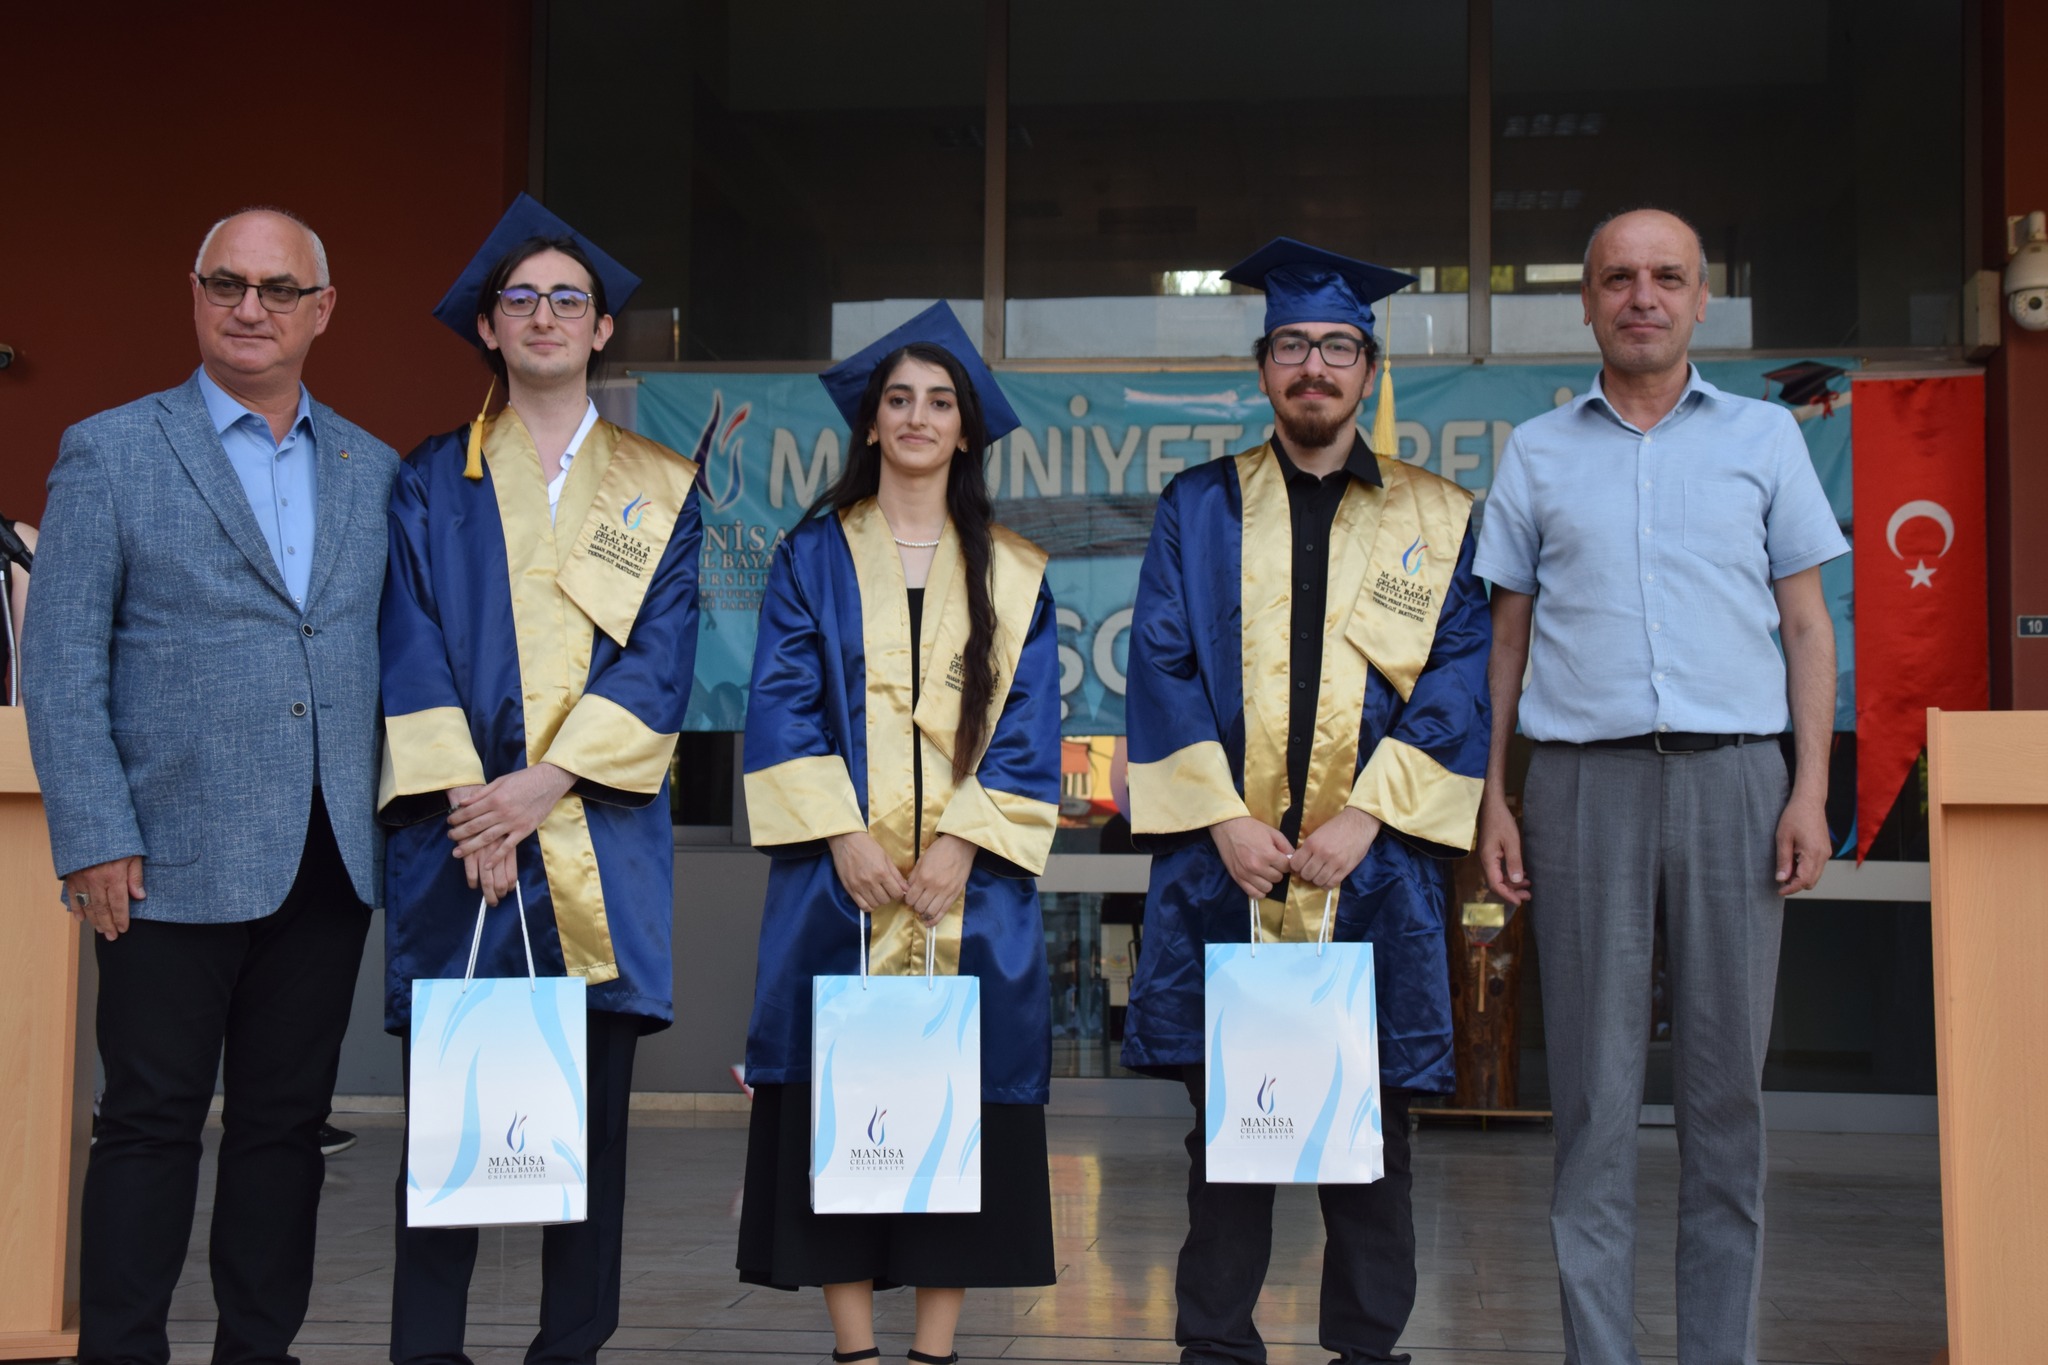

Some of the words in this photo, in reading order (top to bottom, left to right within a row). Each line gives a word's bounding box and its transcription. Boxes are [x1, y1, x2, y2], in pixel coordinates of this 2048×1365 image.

[704, 520, 786, 551] NİSA
[595, 530, 620, 545] CELAL
[622, 542, 648, 559] BAYAR
[722, 553, 774, 568] BAYA
[1377, 577, 1401, 592] CELAL
[1404, 588, 1430, 602] BAYAR
[2027, 620, 2043, 633] 10
[1241, 1115, 1294, 1127] MANİSA
[850, 1146, 904, 1159] MANİSA
[488, 1154, 546, 1167] MANİSA
